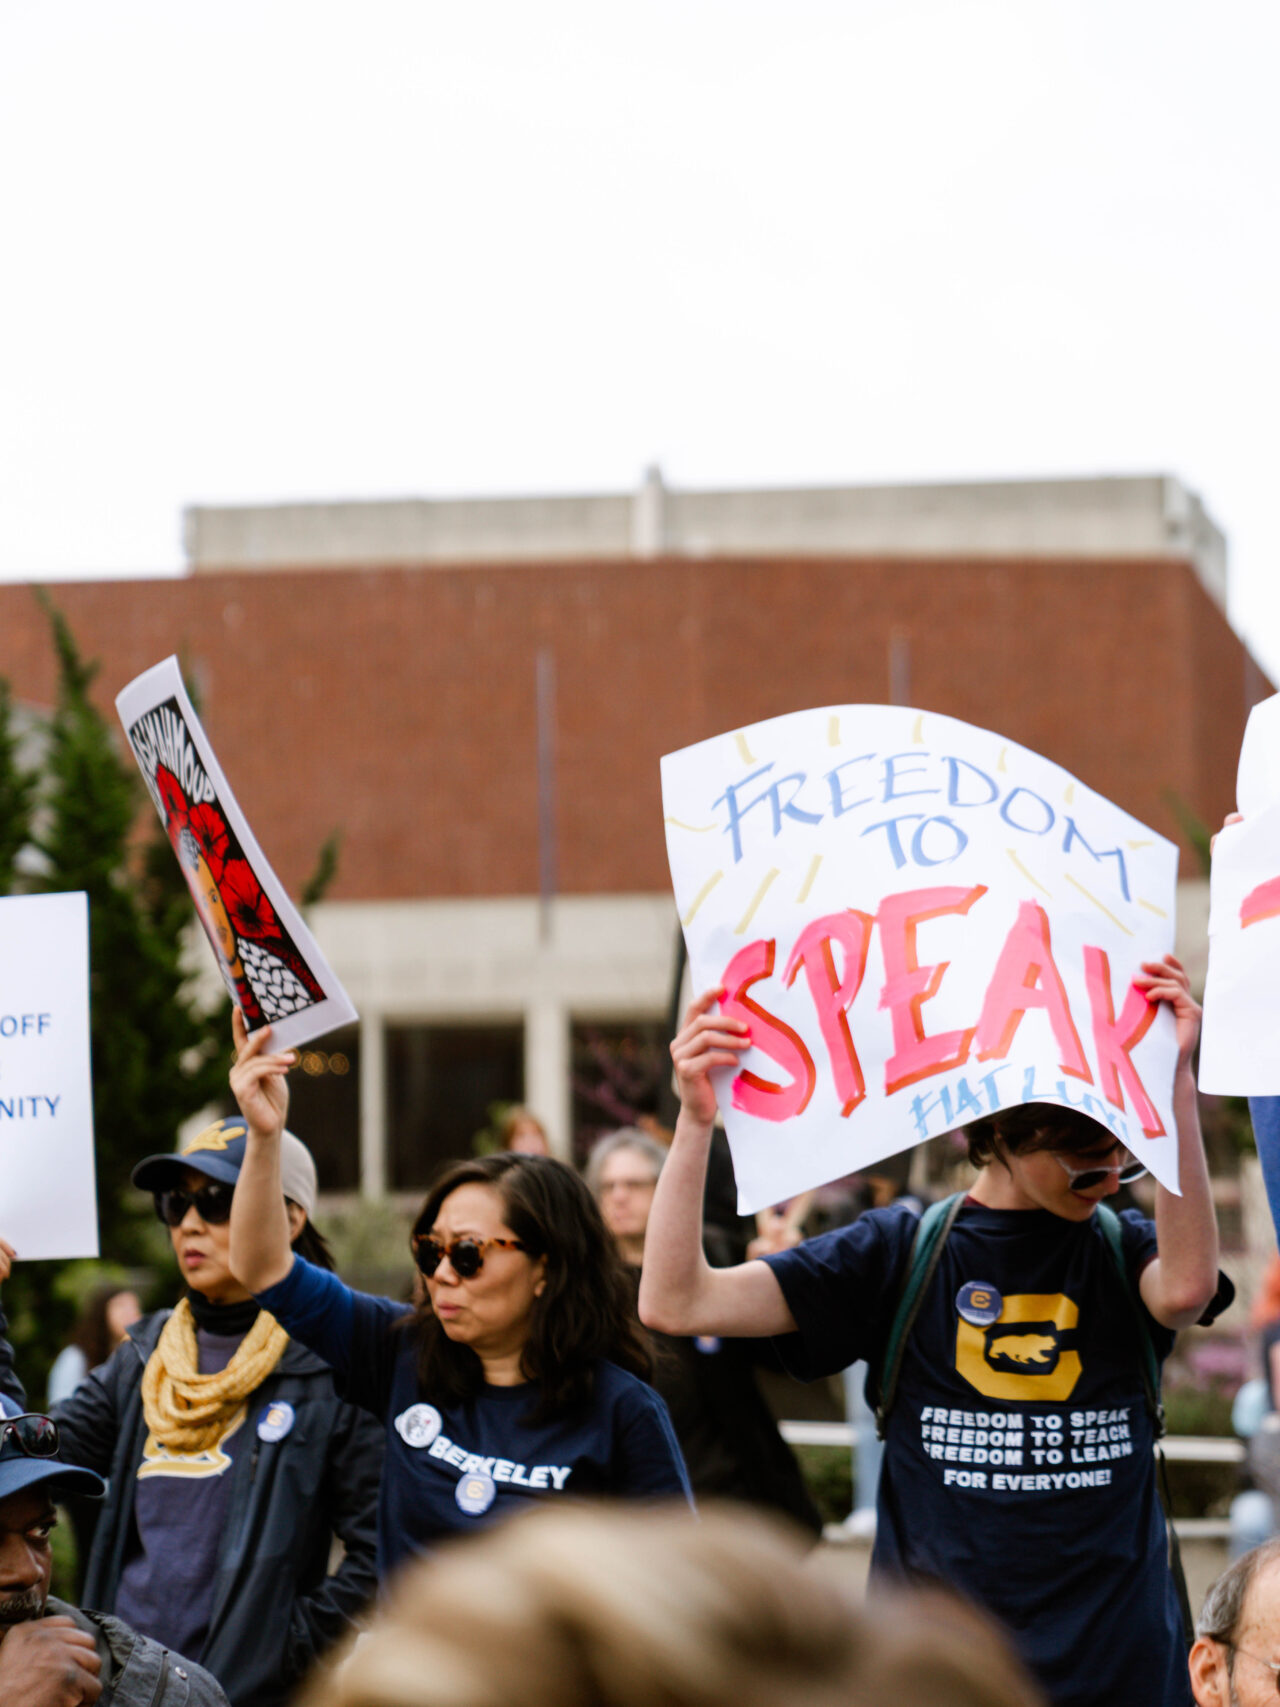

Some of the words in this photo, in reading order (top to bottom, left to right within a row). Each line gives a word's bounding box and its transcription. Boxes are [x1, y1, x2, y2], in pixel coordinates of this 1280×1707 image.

[711, 751, 1132, 904] FREEDOM
[861, 814, 969, 871] TO
[0, 1013, 51, 1036] OFF
[719, 884, 1167, 1139] SPEAK
[908, 1064, 1011, 1139] FIAT
[920, 1406, 1024, 1429] FREEDOM
[1030, 1416, 1062, 1429] TO
[1070, 1407, 1131, 1427] SPEAK
[921, 1425, 1023, 1447] FREEDOM
[1031, 1432, 1063, 1446] TO
[1071, 1424, 1130, 1445] TEACH
[428, 1435, 572, 1490] BERKELEY
[1031, 1451, 1063, 1465] TO
[1071, 1442, 1133, 1463] LEARN
[943, 1469, 987, 1489] FOR
[992, 1469, 1112, 1491] EVERYONE!
